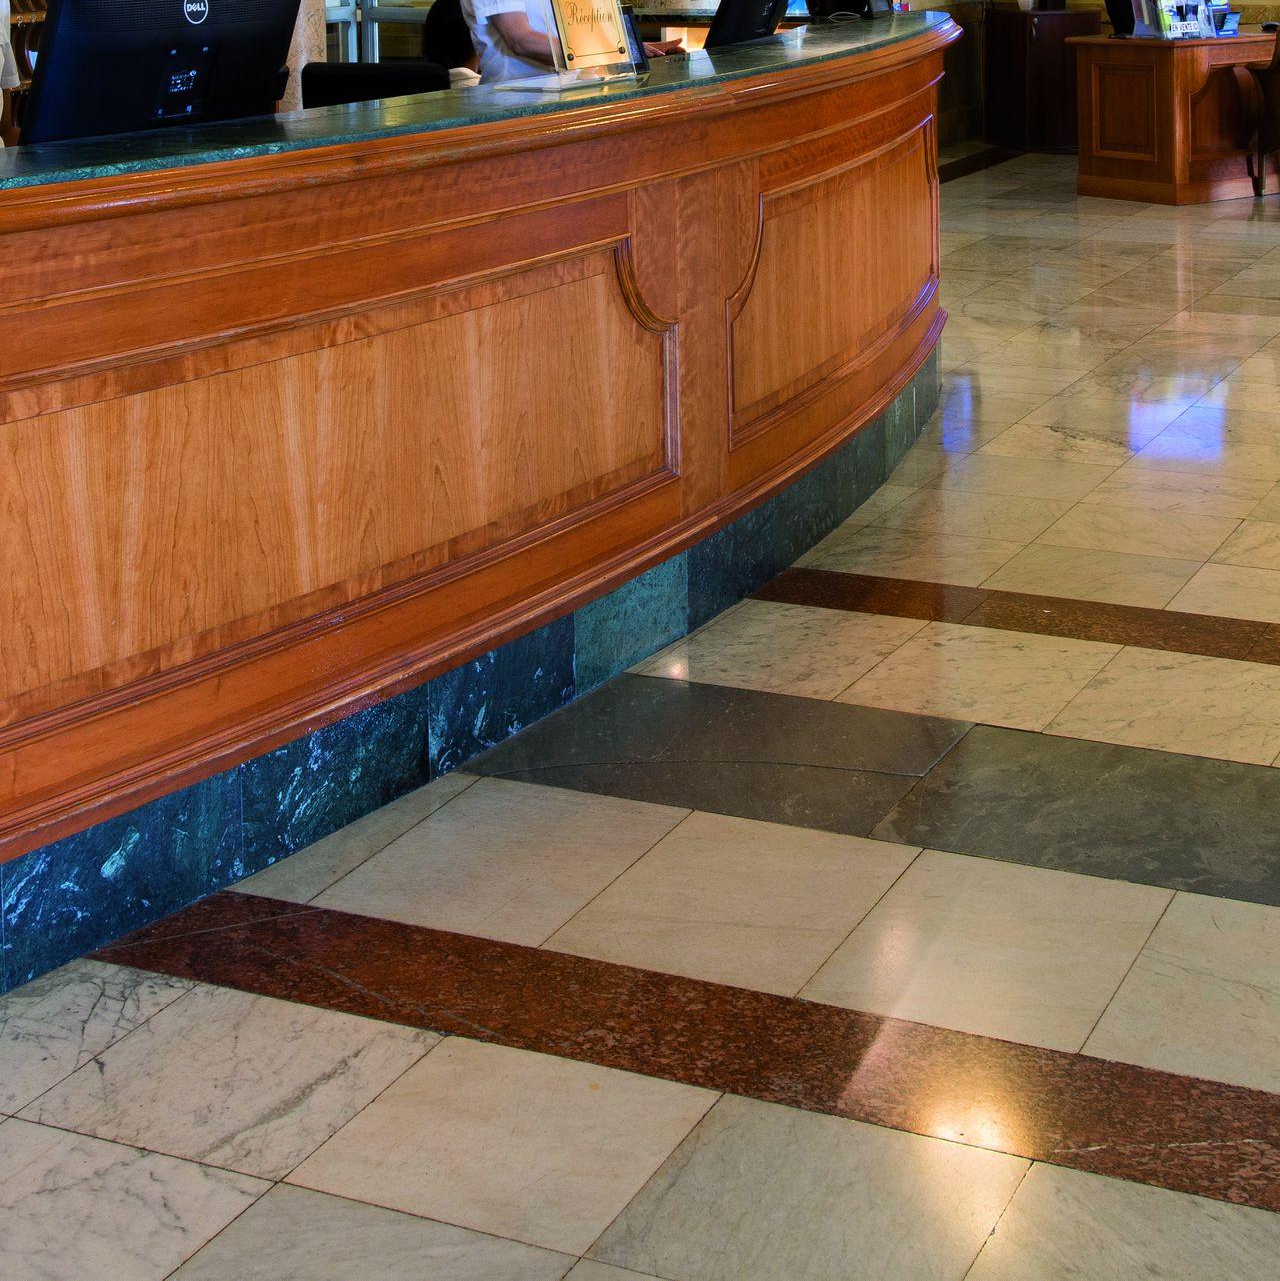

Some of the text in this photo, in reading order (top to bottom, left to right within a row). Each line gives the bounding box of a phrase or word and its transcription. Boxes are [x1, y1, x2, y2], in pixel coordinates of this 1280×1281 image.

[186, 3, 206, 12] DELL
[566, 1, 613, 32] Réception
[1171, 23, 1178, 32] EN
[1179, 23, 1193, 32] VENTE
